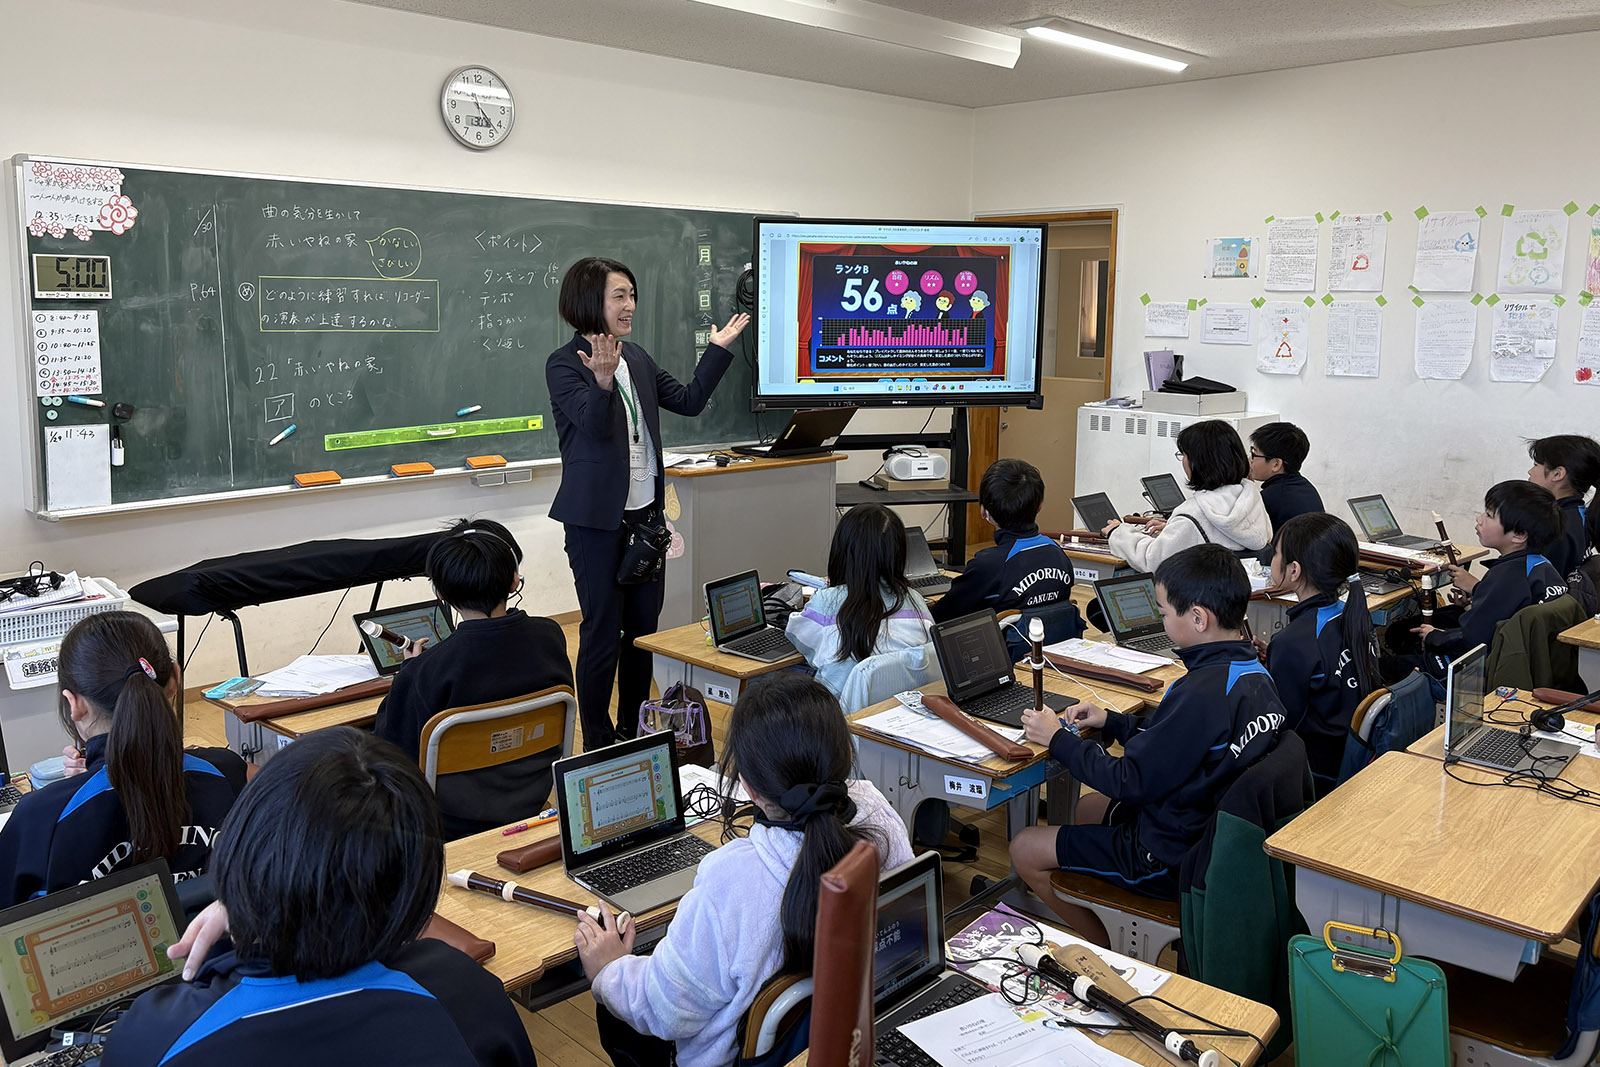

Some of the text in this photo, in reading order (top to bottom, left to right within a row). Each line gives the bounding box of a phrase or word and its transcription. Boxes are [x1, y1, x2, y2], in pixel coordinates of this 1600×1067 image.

[473, 74, 482, 84] 12
[451, 99, 457, 109] 9
[499, 106, 506, 116] 3
[454, 114, 461, 125] 8
[475, 131, 482, 141] 6
[488, 129, 495, 139] 5
[261, 203, 361, 221] 曲の気分を生かして
[265, 232, 359, 249] 赤いやねの家
[378, 236, 419, 248] かなしい
[377, 257, 414, 269] さびしい
[835, 264, 870, 275] ランクB
[56, 257, 106, 289] 5:00
[483, 268, 538, 285] タンギング
[480, 291, 514, 306] テンポ
[840, 278, 898, 315] 56 点
[478, 313, 527, 331] 指づかい
[818, 355, 845, 363] コメント
[308, 390, 354, 409] のところ
[1011, 567, 1072, 597] MIDORINO
[1026, 591, 1060, 606] GAKUEN
